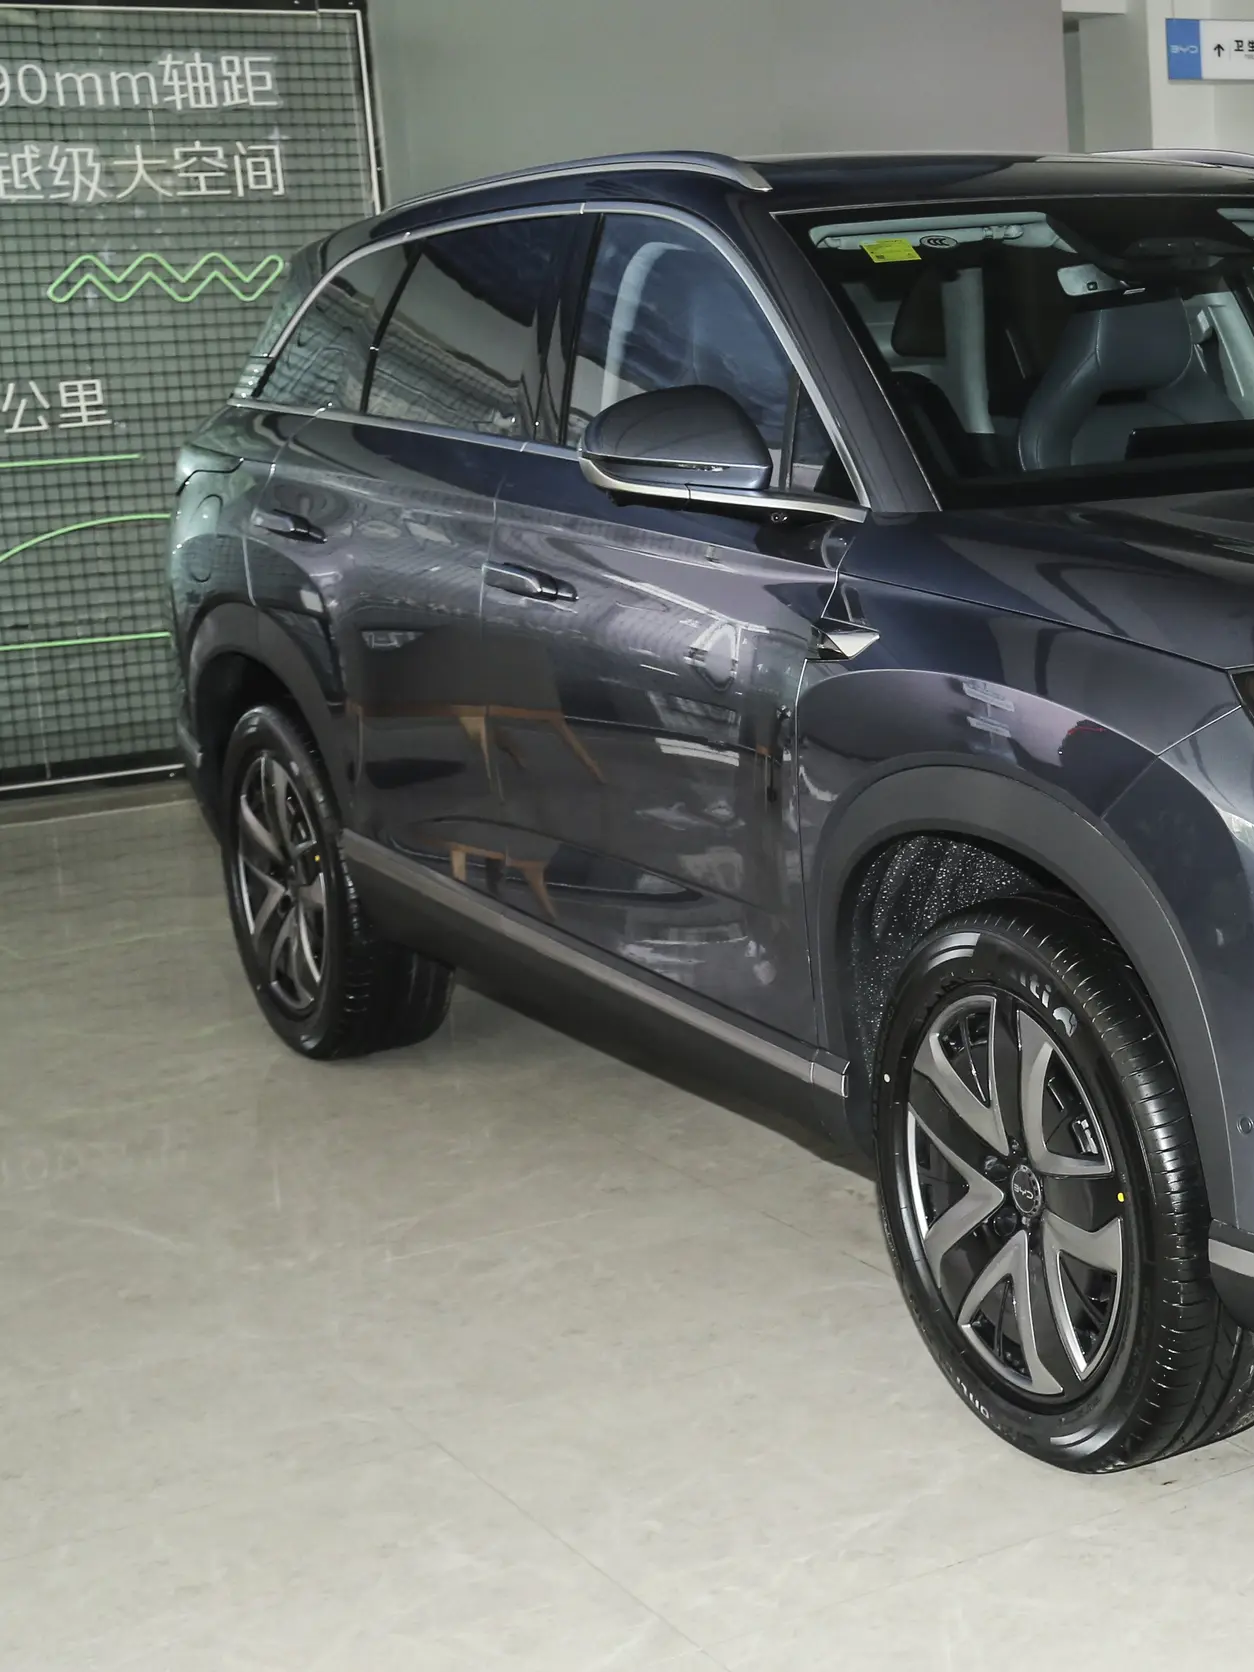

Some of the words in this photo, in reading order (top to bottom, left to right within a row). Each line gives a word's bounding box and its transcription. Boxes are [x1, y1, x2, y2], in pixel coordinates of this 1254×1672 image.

[0, 141, 285, 202] 越级大空间
[2, 379, 112, 434] 公里
[1013, 1183, 1034, 1200] BYD
